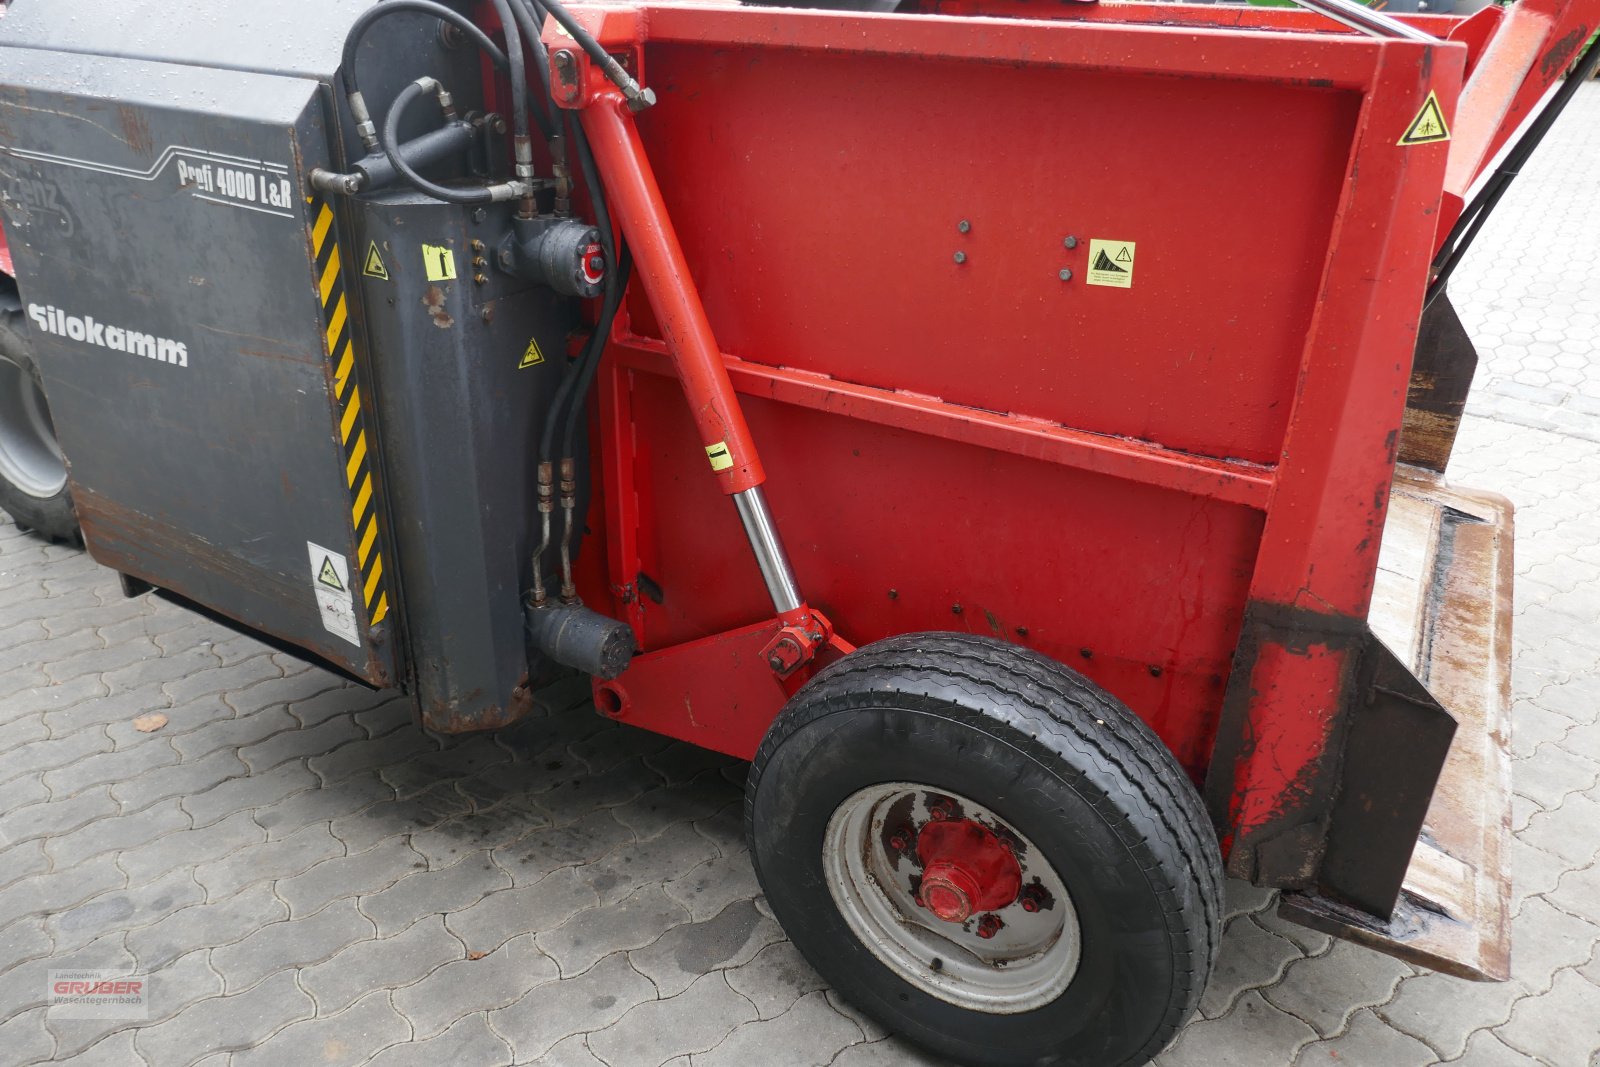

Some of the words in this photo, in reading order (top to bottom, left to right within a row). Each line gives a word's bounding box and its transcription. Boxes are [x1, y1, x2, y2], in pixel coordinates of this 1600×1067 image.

[177, 159, 213, 192] Profi
[217, 167, 256, 202] 4000
[260, 175, 292, 209] L&R
[28, 303, 188, 368] Silokamm
